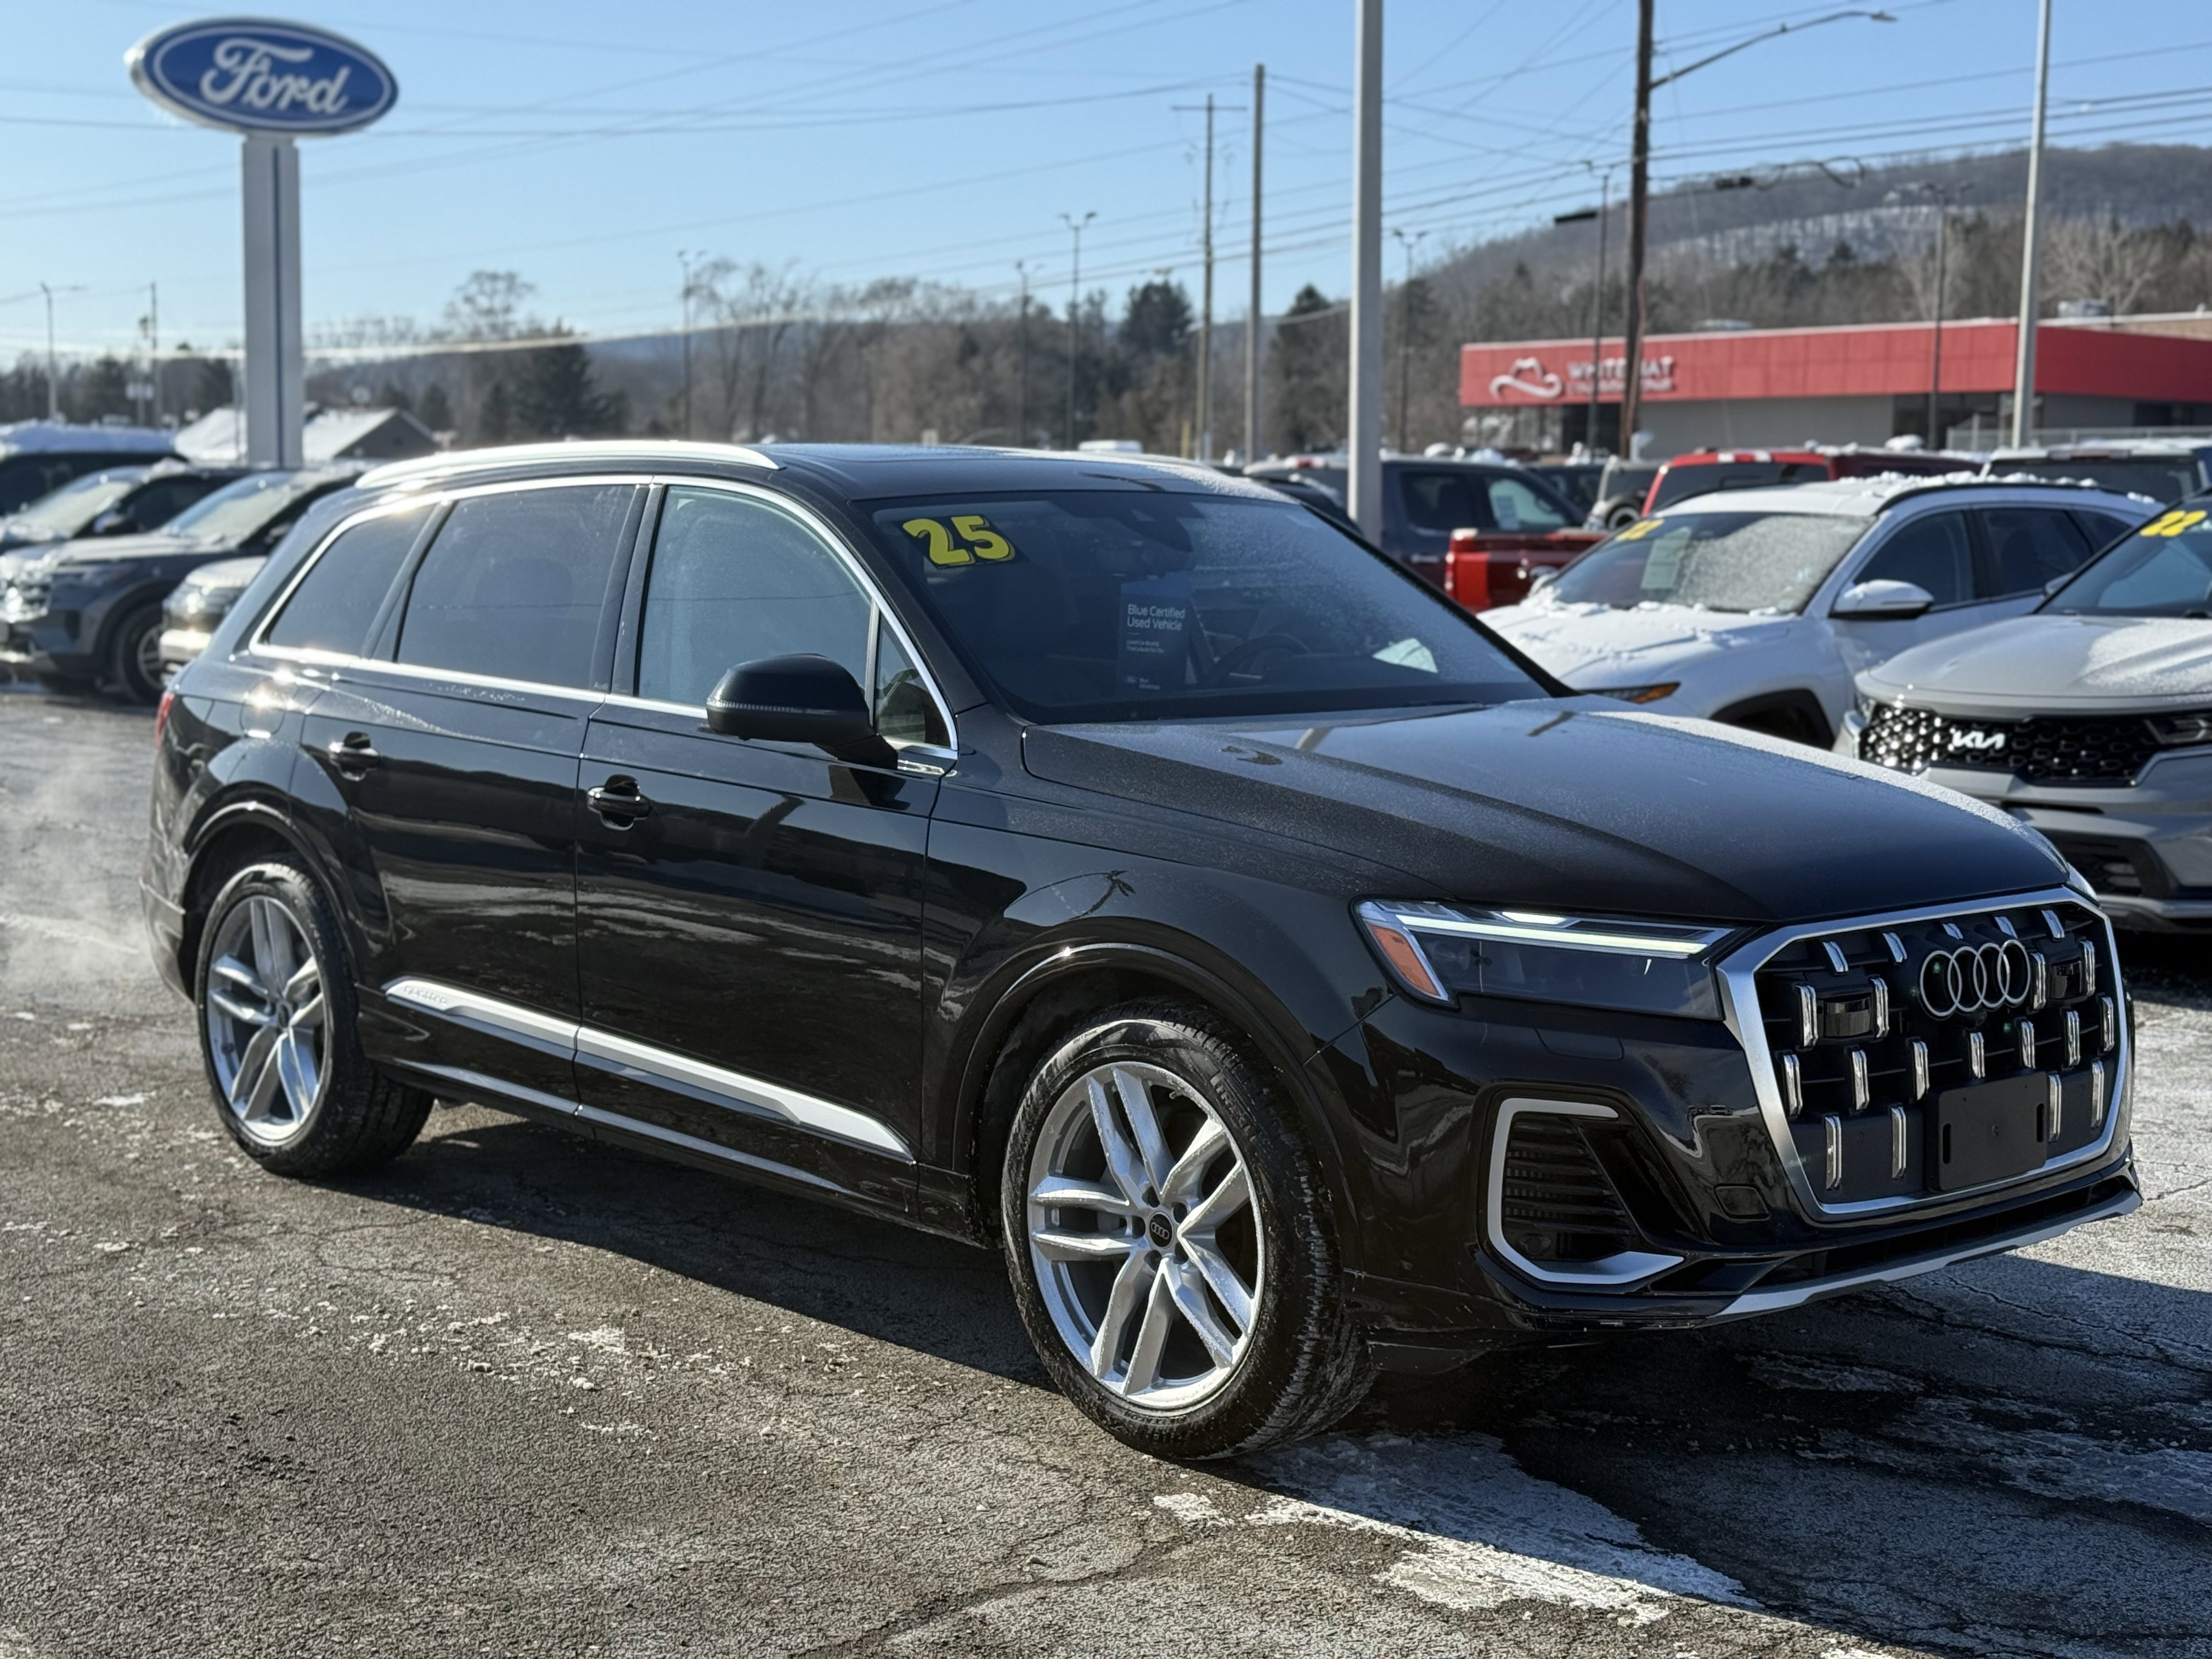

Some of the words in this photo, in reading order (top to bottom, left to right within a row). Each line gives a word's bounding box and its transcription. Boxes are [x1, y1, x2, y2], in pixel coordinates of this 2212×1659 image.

[200, 37, 352, 114] Ford
[902, 515, 1015, 566] 25
[1127, 603, 1148, 616] Blue
[1149, 606, 1186, 619] Certified
[1127, 617, 1150, 628] Used
[1152, 618, 1183, 631] Vehicle
[1952, 730, 2006, 750] KIA
[404, 985, 448, 1004] quattro
